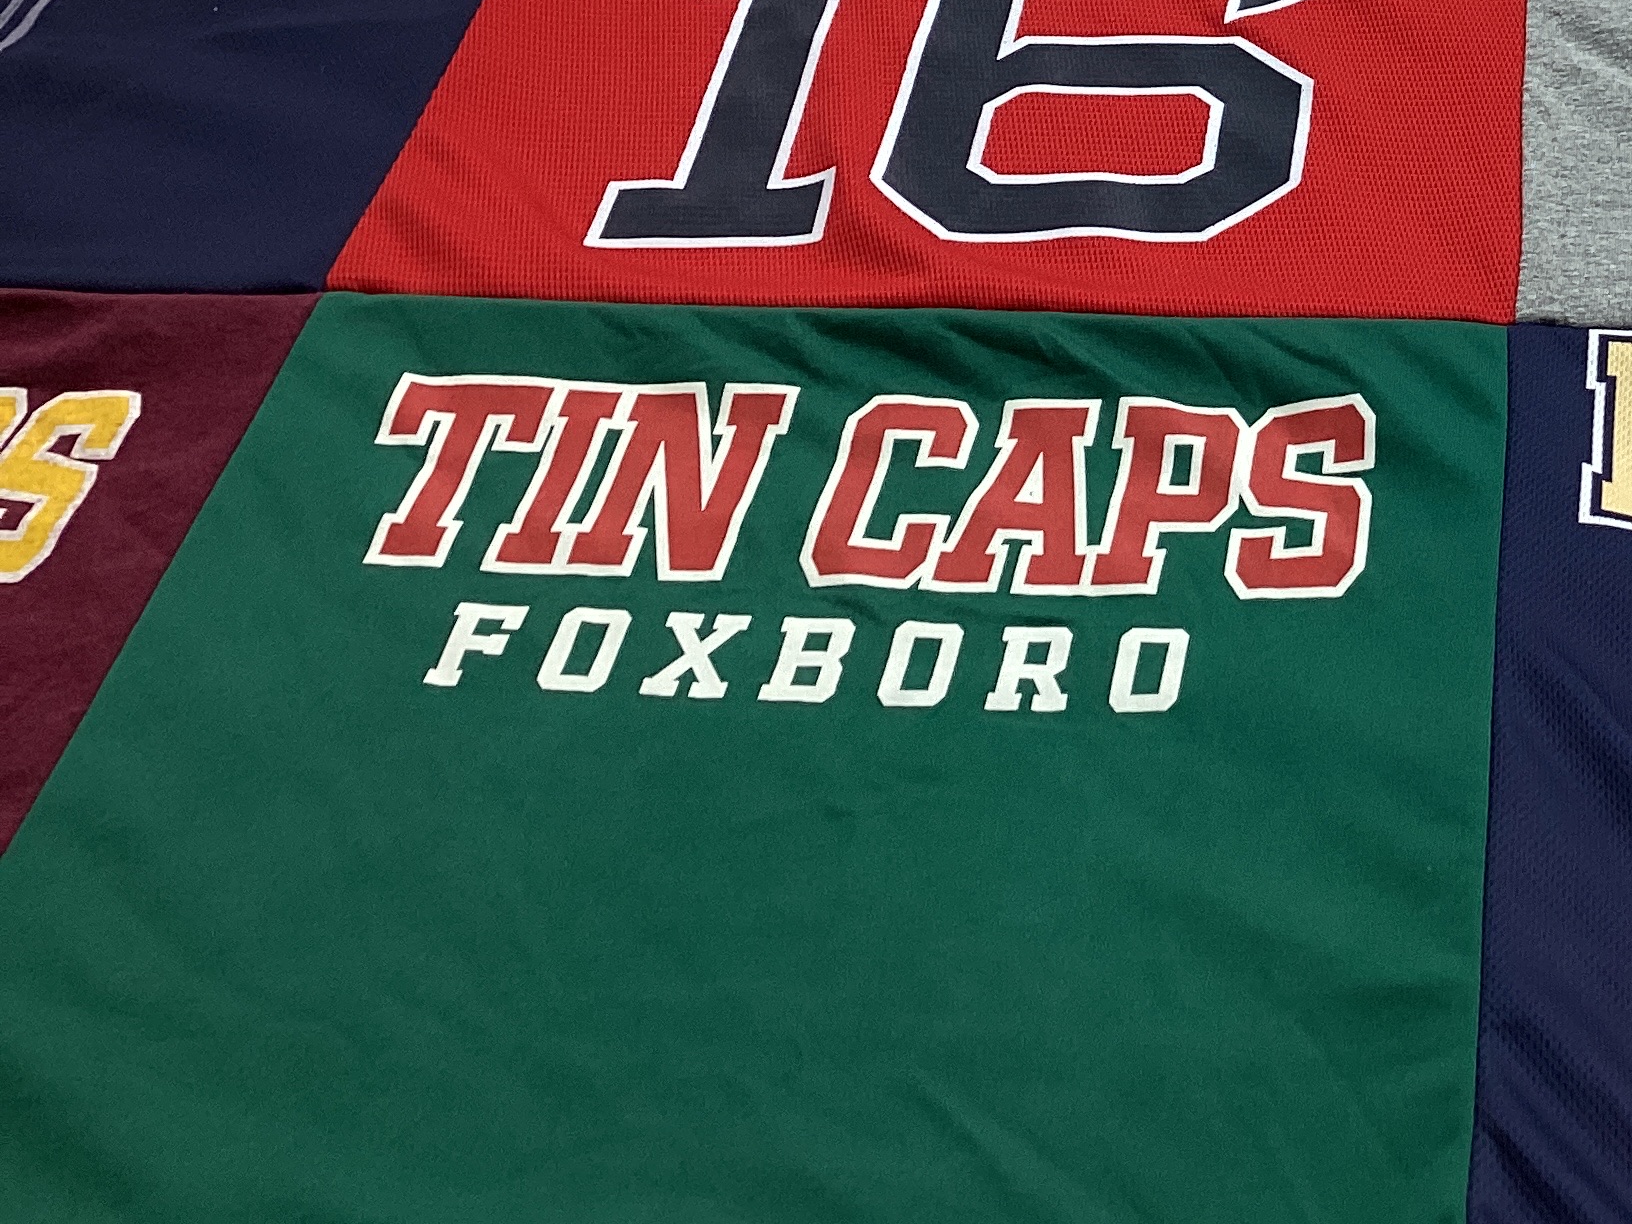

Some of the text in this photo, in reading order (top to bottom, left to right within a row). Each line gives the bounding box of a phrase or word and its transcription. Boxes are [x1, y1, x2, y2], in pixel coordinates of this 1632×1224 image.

[363, 372, 1377, 600] TIN CAPS
[422, 602, 1191, 714] FOXBORO
